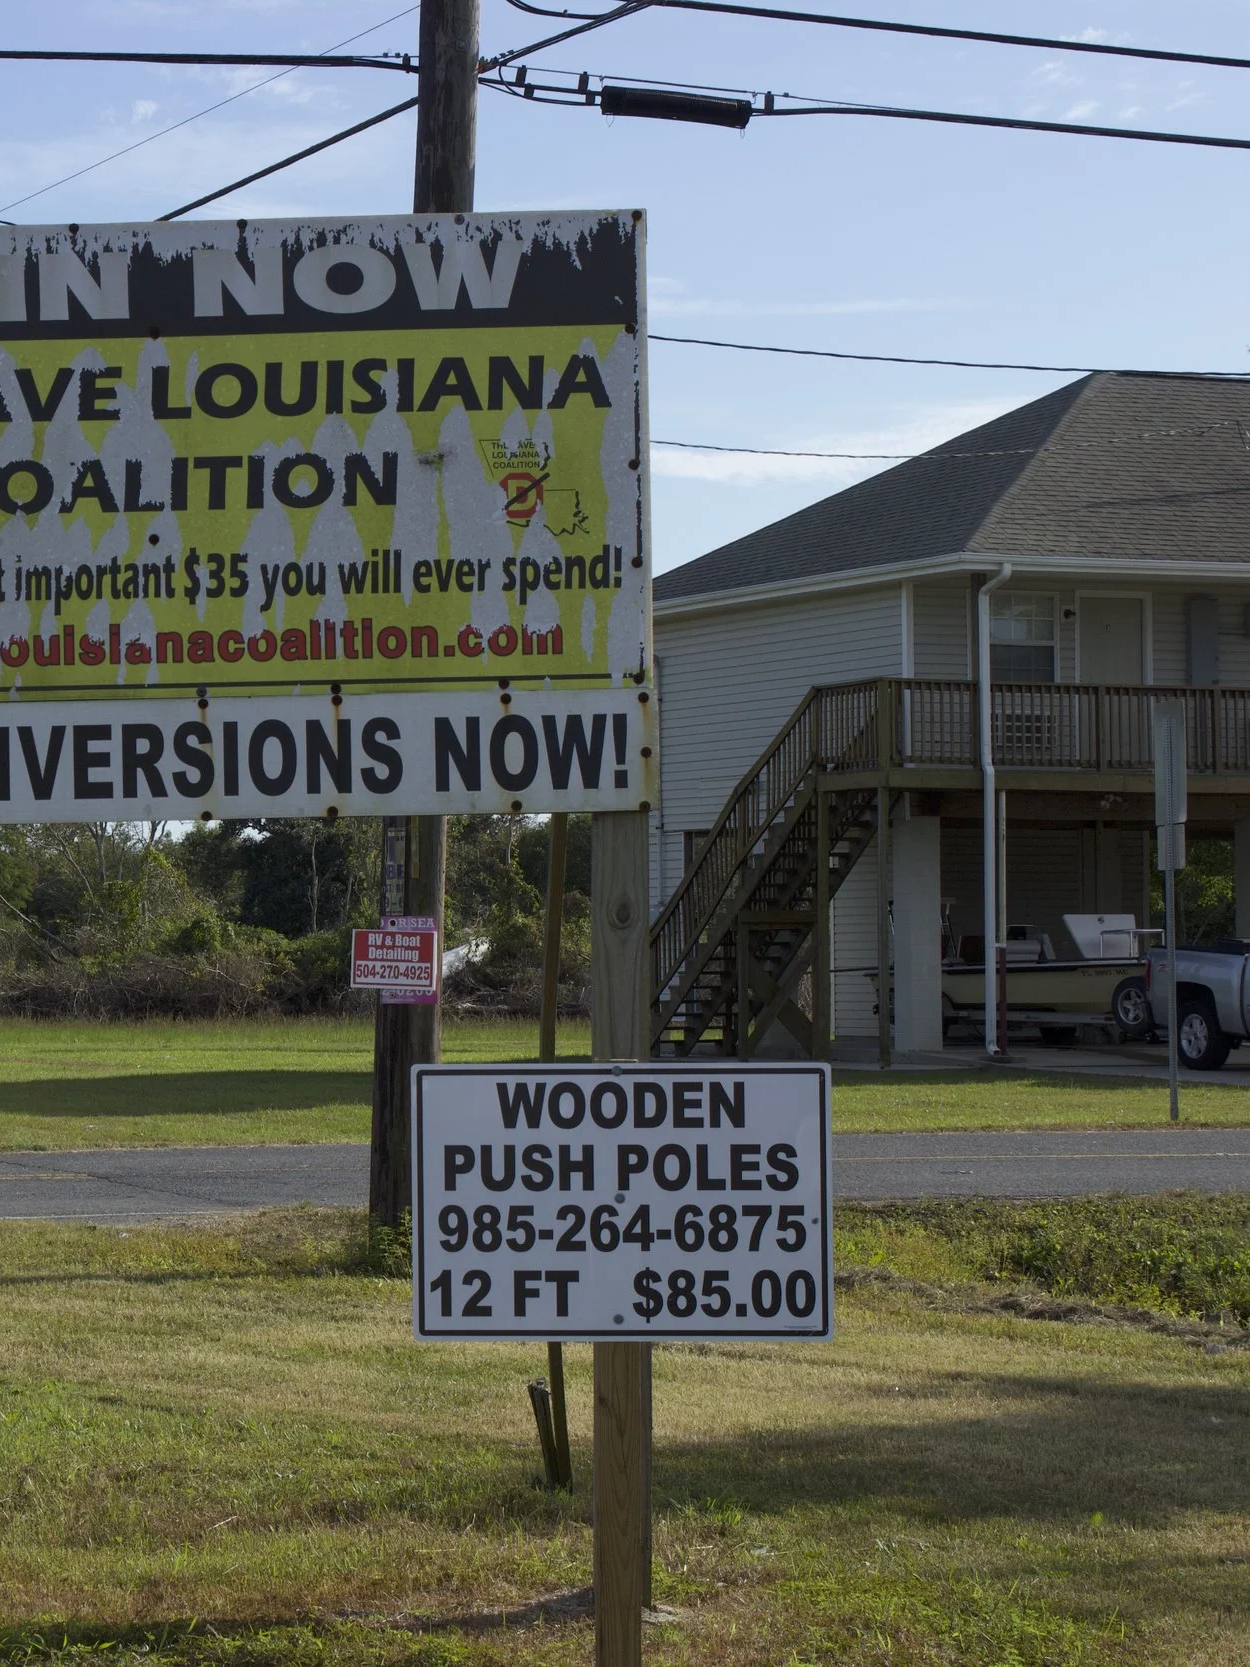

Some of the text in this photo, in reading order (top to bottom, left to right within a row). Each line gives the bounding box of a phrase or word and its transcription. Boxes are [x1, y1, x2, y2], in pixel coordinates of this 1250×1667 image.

[192, 240, 524, 318] NOW
[151, 354, 612, 420] LOUISIANA
[493, 461, 540, 469] COALITION
[15, 552, 176, 616] important
[183, 547, 249, 605] $35
[260, 561, 327, 613] you
[337, 548, 401, 595] will
[412, 556, 491, 594] ever
[502, 544, 623, 605] spend!
[434, 713, 629, 792] NOW!
[368, 934, 421, 946] RV & Boat
[368, 947, 419, 961] Detailing
[356, 964, 430, 980] 504-270-4925
[496, 1081, 746, 1129] WOODEN
[444, 1143, 800, 1191] PUSH POLES
[438, 1204, 807, 1252] 985-264-6875
[429, 1267, 816, 1323] 12 FT $85.00
